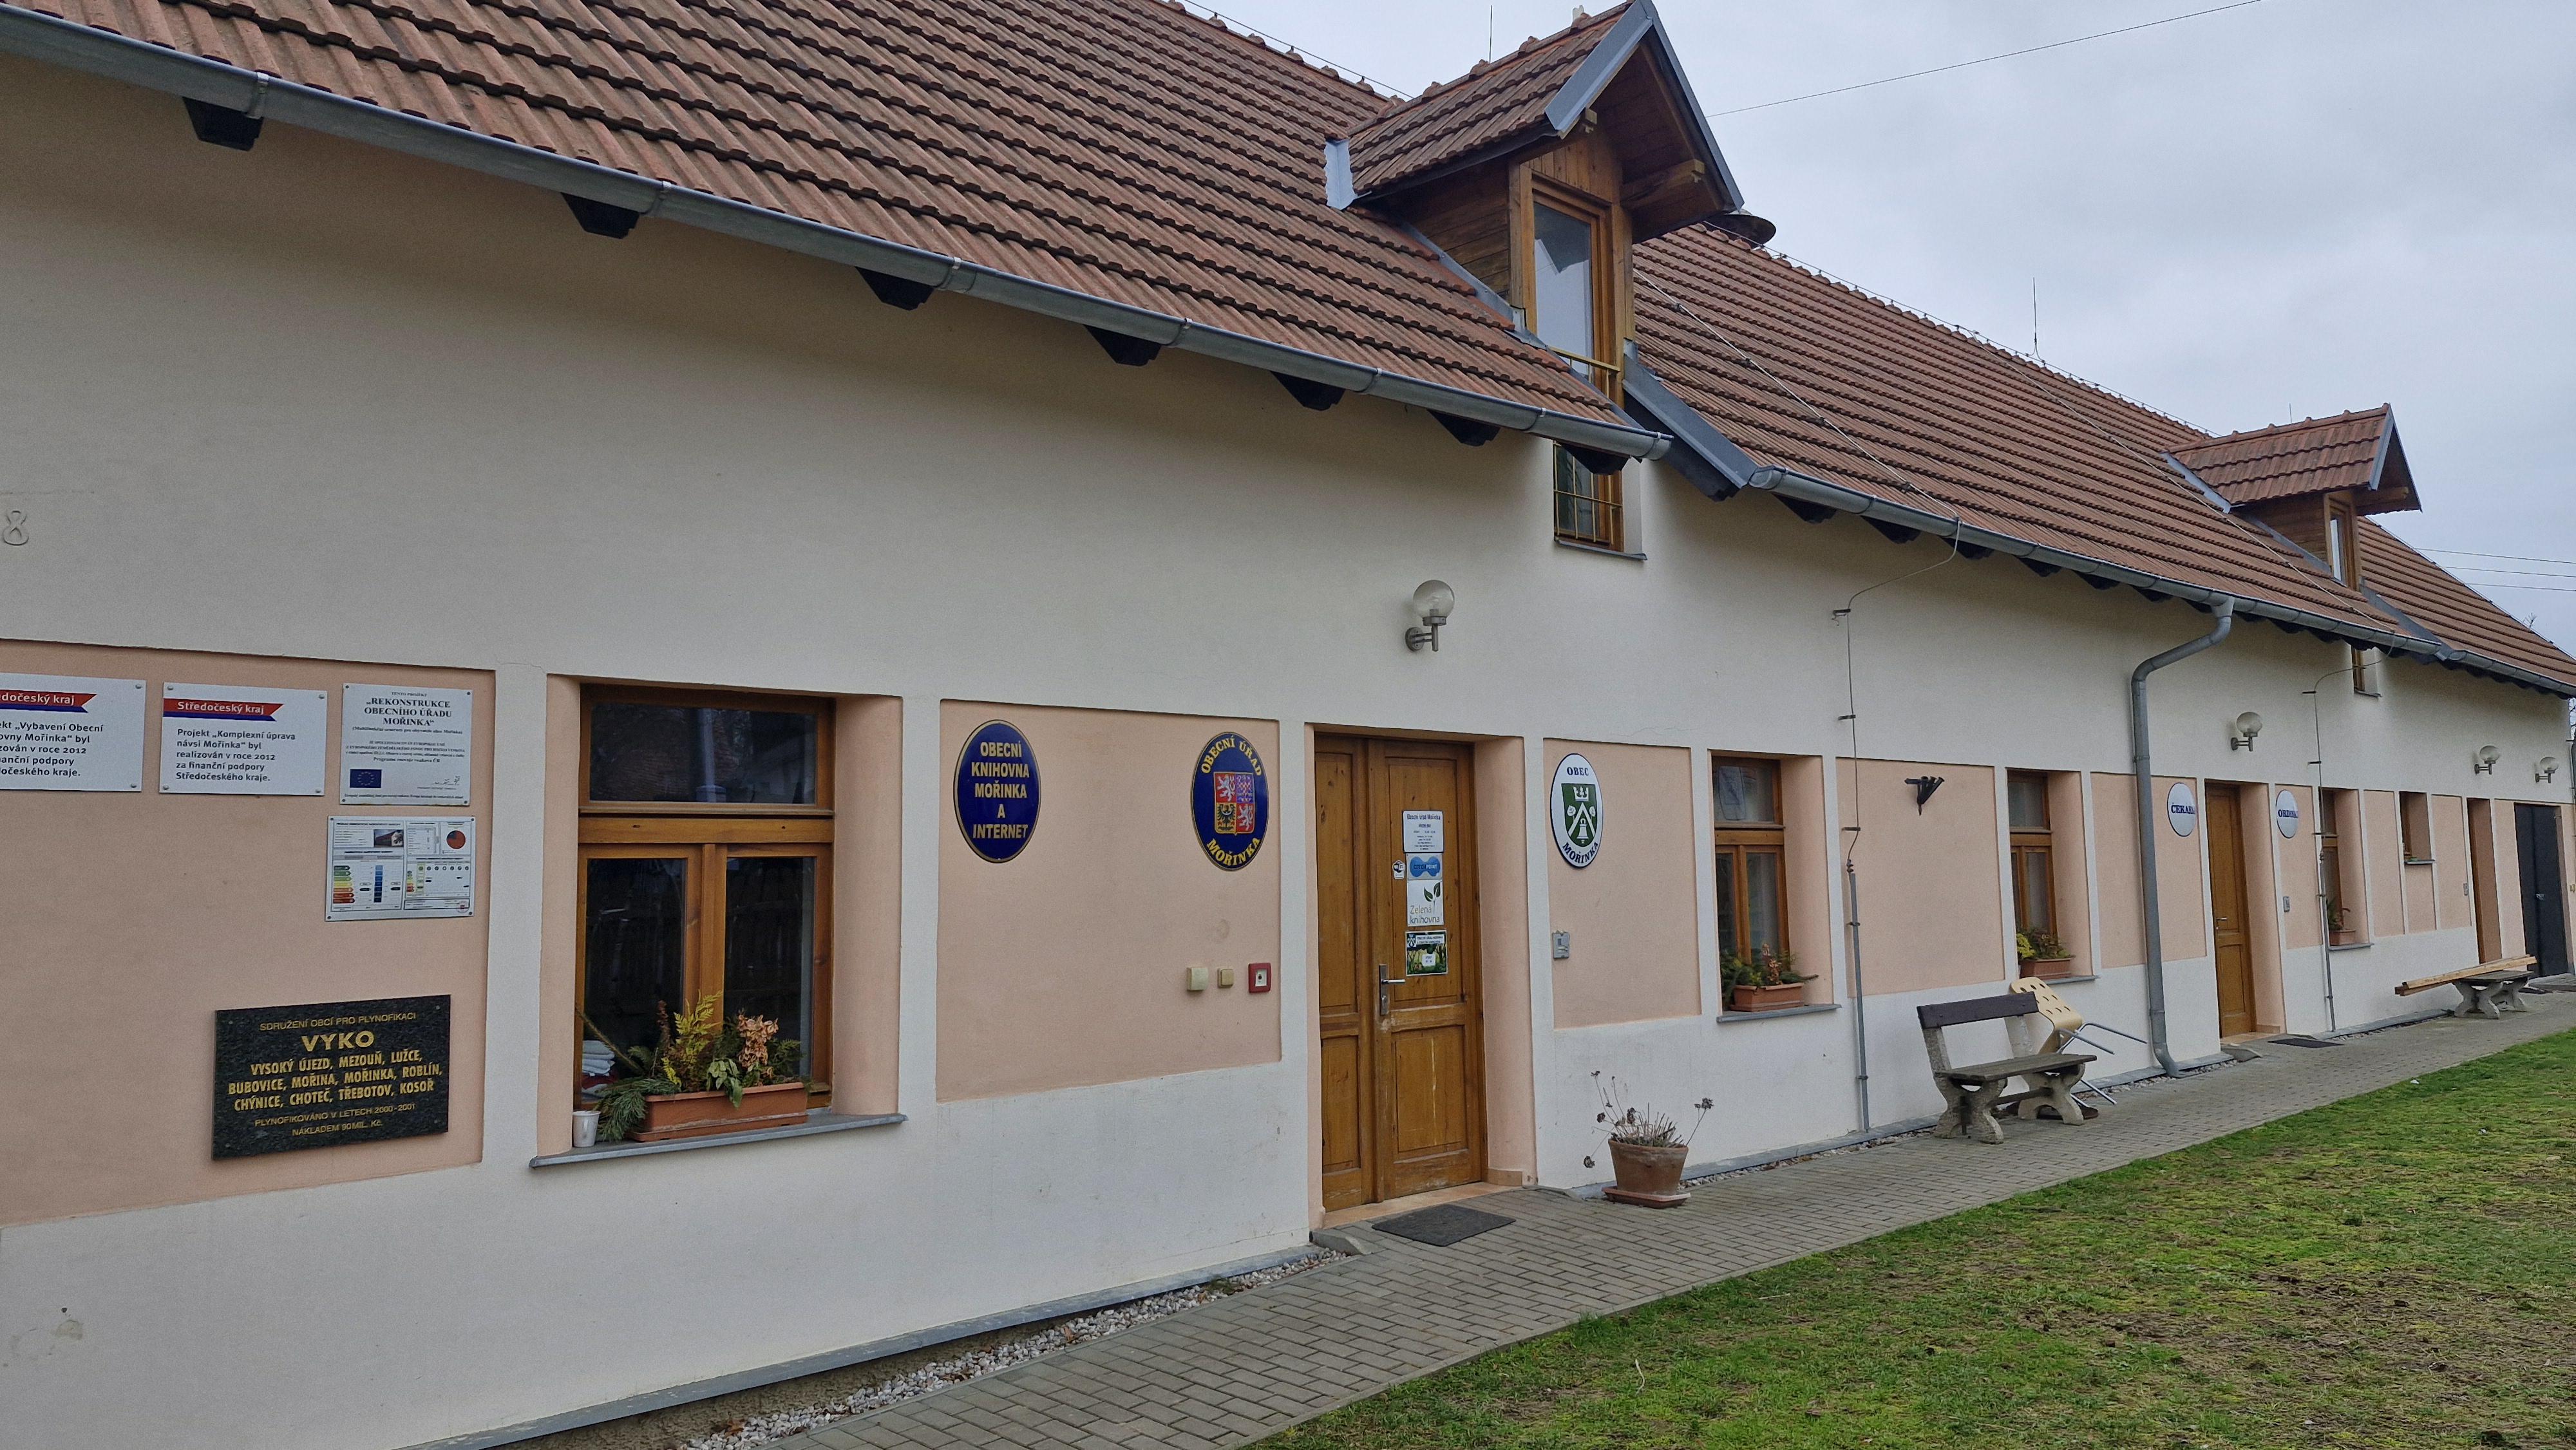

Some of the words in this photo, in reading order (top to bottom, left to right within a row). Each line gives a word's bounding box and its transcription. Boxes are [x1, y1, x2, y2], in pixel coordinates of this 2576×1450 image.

[53, 695, 75, 706] kraj
[177, 701, 243, 713] Středočeský
[245, 704, 264, 715] kraj
[364, 706, 417, 716] OBECNÍHO
[419, 708, 452, 717] ÚŘADU
[69, 724, 104, 733] Obecní
[177, 729, 209, 738] Projekt
[267, 731, 296, 740] úprava
[75, 735, 90, 745] byl
[249, 742, 261, 751] byl
[980, 740, 1022, 758] OBECNÍ
[1201, 735, 1236, 773] OBECNÍ
[1239, 740, 1262, 776] ÚŘAD
[32, 757, 74, 766] podpory
[189, 761, 225, 770] finanční
[227, 762, 265, 772] podpory
[53, 768, 80, 778] kraje.
[176, 771, 243, 781] Středočeského
[246, 773, 270, 783] kraje.
[971, 762, 1030, 778] KNIHOVNA
[1567, 766, 1589, 777] OBEC
[974, 780, 1027, 798] MOŘINKA
[997, 804, 1006, 818] A
[972, 824, 1028, 839] INTERNET
[1206, 837, 1261, 866] MOŘINKA
[1562, 842, 1598, 864] MOŘINKA
[1410, 905, 1432, 914] Zelená
[1410, 915, 1440, 924] knihovna
[260, 1018, 308, 1031] SDRUŽENÍ
[310, 1017, 334, 1027] OBCÍ
[336, 1016, 355, 1026] PRO
[358, 1012, 416, 1024] PLYNOFIKACI
[301, 1030, 375, 1052] VYKO
[251, 1058, 294, 1076] VYSOKÝ
[299, 1057, 334, 1072] ÚJEZD,
[339, 1051, 386, 1068] MEZOUŇ,
[391, 1048, 422, 1063] LUŽCE,
[229, 1078, 287, 1095] BUBOVICE,
[291, 1072, 339, 1089] MOŘINA,
[344, 1068, 397, 1084] MOŘINKA,
[402, 1061, 442, 1078] ROBLÍN,
[234, 1095, 284, 1112] CHÝNICE,
[290, 1087, 334, 1106] CHOTEČ,
[338, 1084, 395, 1100] TŘEBOTOV,
[400, 1078, 434, 1094] KOSOŘ
[254, 1112, 328, 1127] PLYNOFIKOVÁNO
[339, 1107, 372, 1118] LETECH
[292, 1124, 341, 1136] NÁKLADEM
